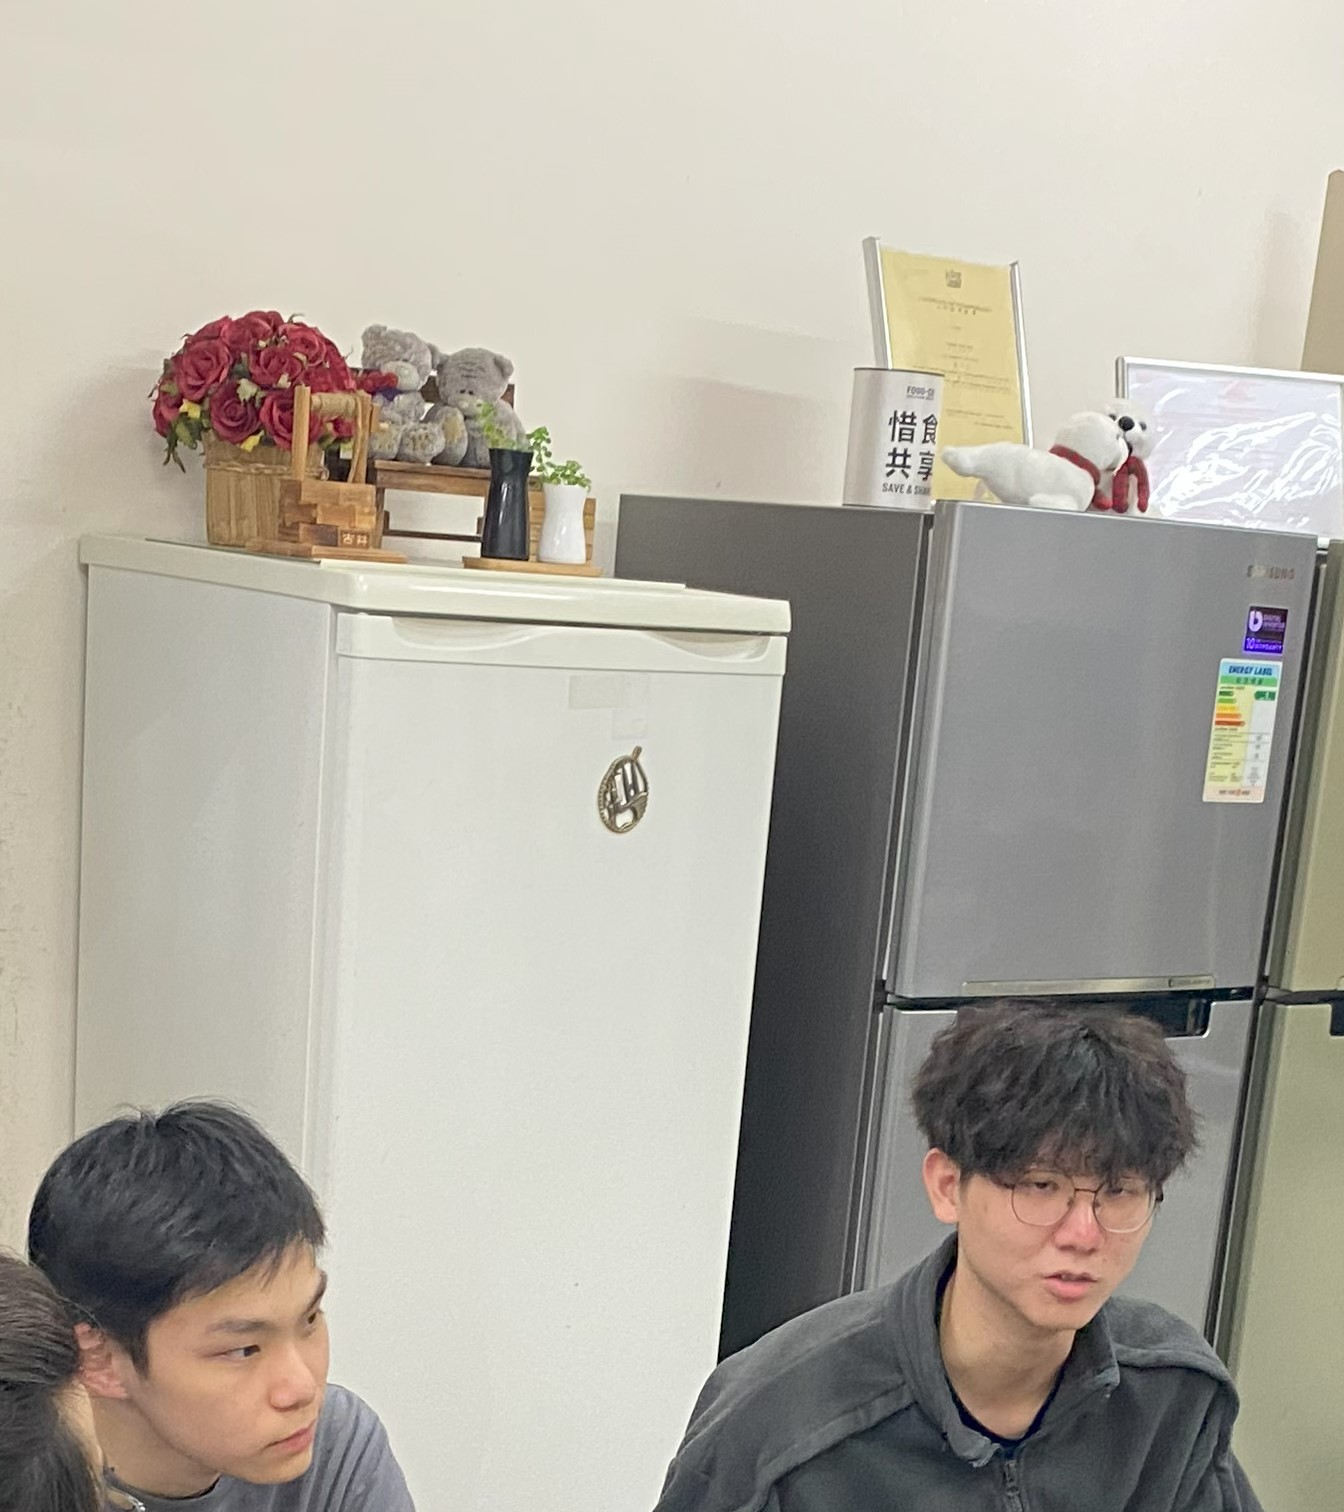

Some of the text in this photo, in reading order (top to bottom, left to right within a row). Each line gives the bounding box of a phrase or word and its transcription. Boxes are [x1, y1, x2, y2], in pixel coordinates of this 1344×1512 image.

[888, 410, 939, 445] 惜食
[885, 447, 935, 481] 共享
[882, 483, 904, 494] SAVE
[906, 485, 912, 494] &
